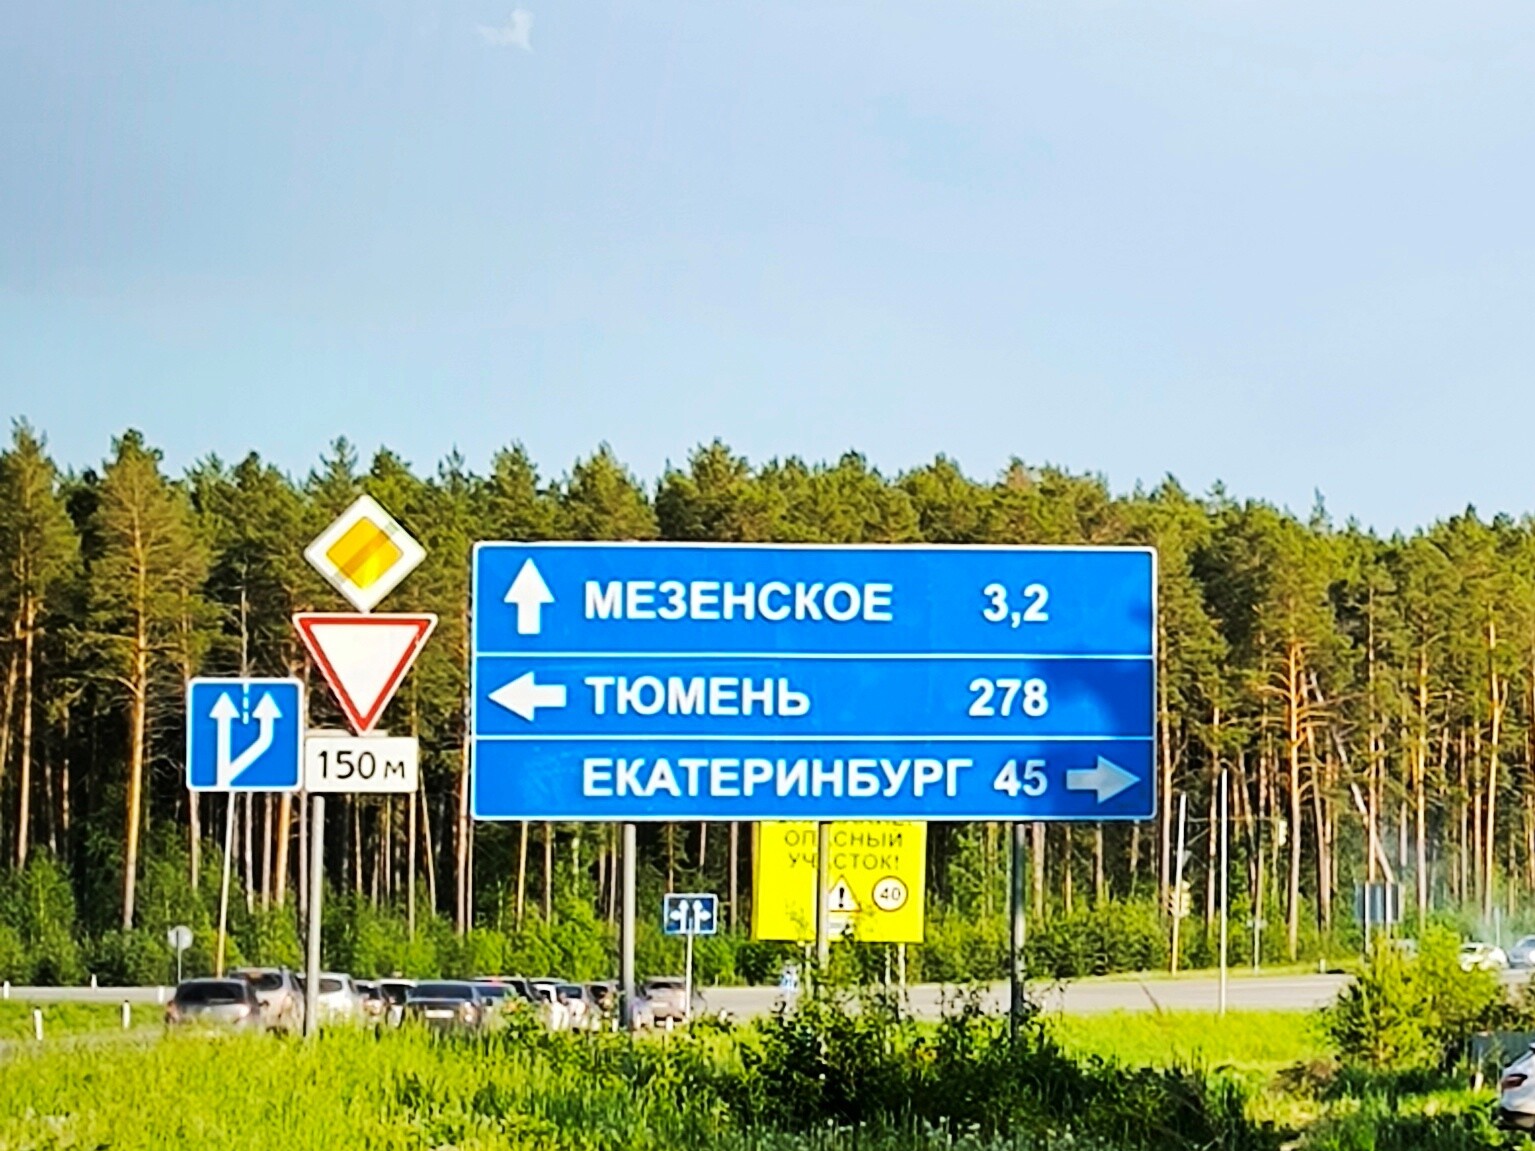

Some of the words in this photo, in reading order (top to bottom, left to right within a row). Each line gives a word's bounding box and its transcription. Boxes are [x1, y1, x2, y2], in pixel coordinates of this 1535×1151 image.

[584, 580, 894, 622] МЕЗЕНСКОЕ
[982, 582, 1050, 629] 3,2
[584, 675, 812, 717] ТЮМЕНЬ
[967, 677, 1049, 717] 278
[318, 750, 376, 780] 150
[582, 757, 974, 798] ЕКАТЕРИНБУРГ
[993, 758, 1048, 797] 45
[784, 829, 904, 848] ОПСНЫЙ
[788, 852, 900, 871] УЧСТОК!
[879, 886, 902, 901] 40
